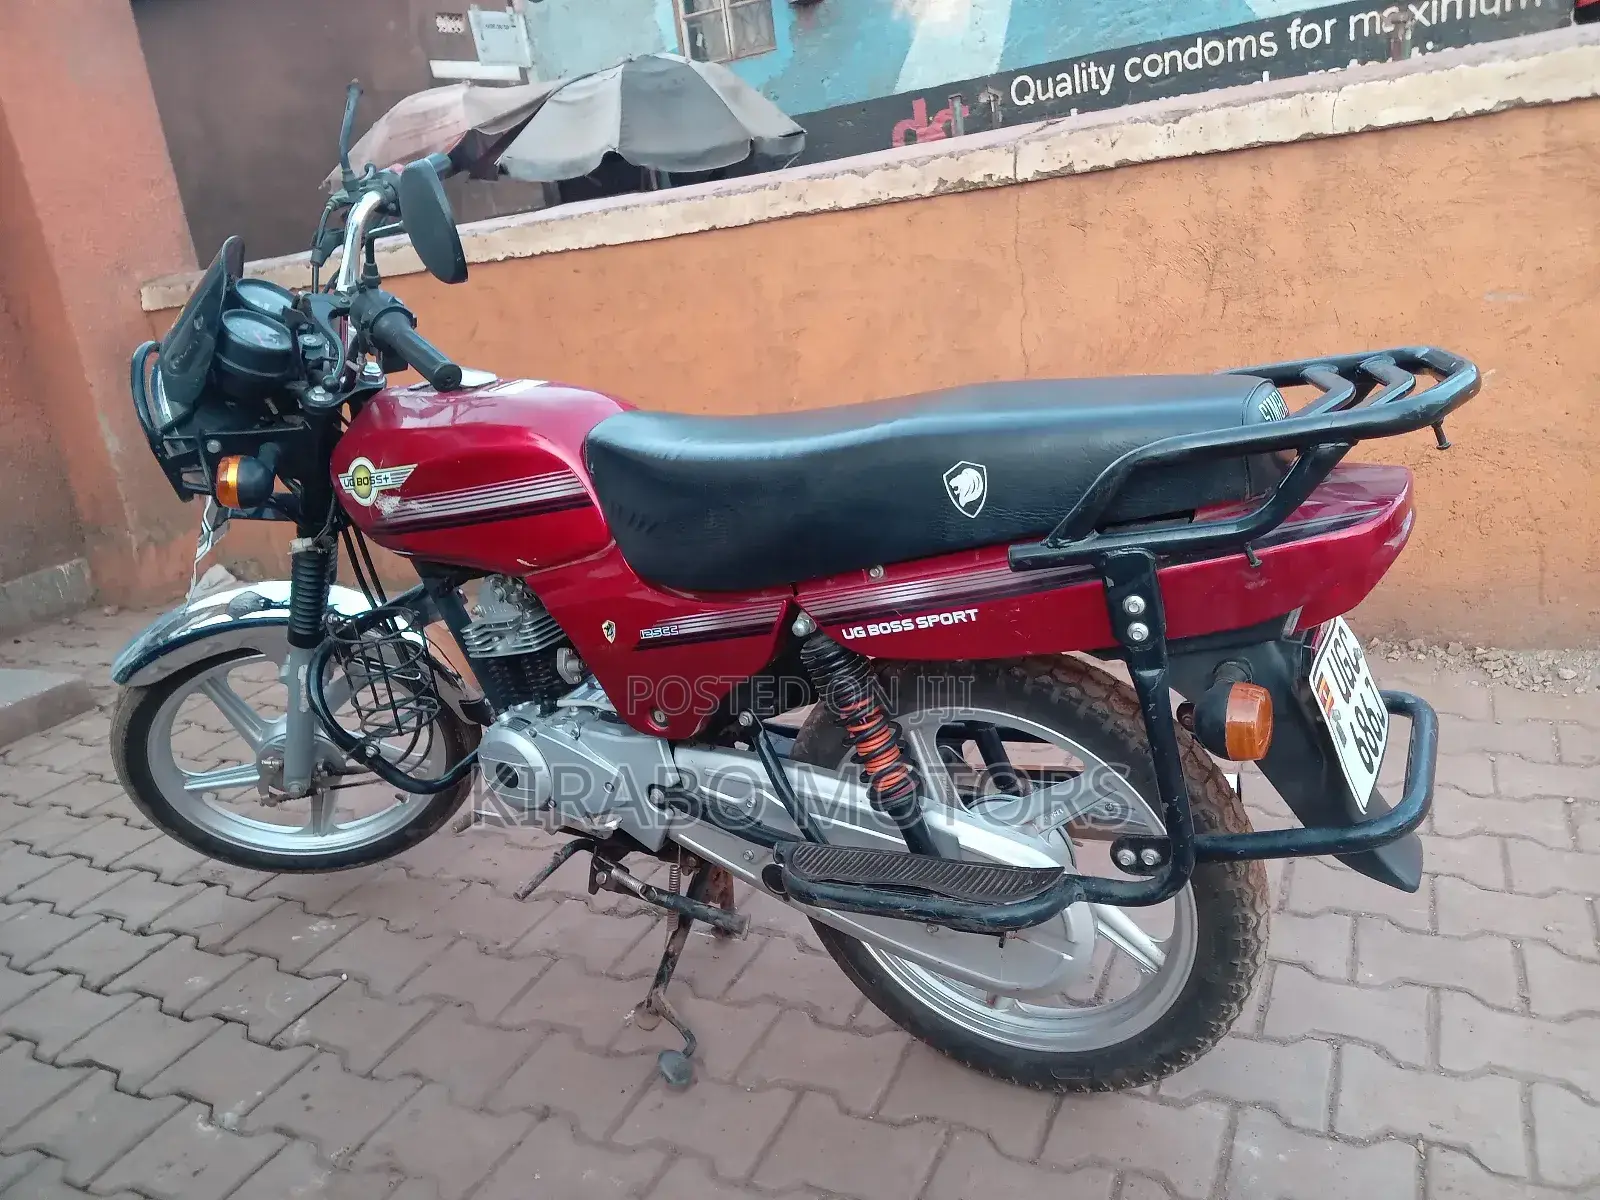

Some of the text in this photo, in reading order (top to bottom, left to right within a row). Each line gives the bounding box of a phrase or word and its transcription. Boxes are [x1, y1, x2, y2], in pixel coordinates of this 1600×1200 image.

[1010, 60, 1116, 106] Quality
[1124, 31, 1279, 84] condoms
[1286, 17, 1338, 50] for
[841, 608, 979, 640] UG BOSS SPORT
[1349, 676, 1386, 774] 686J
